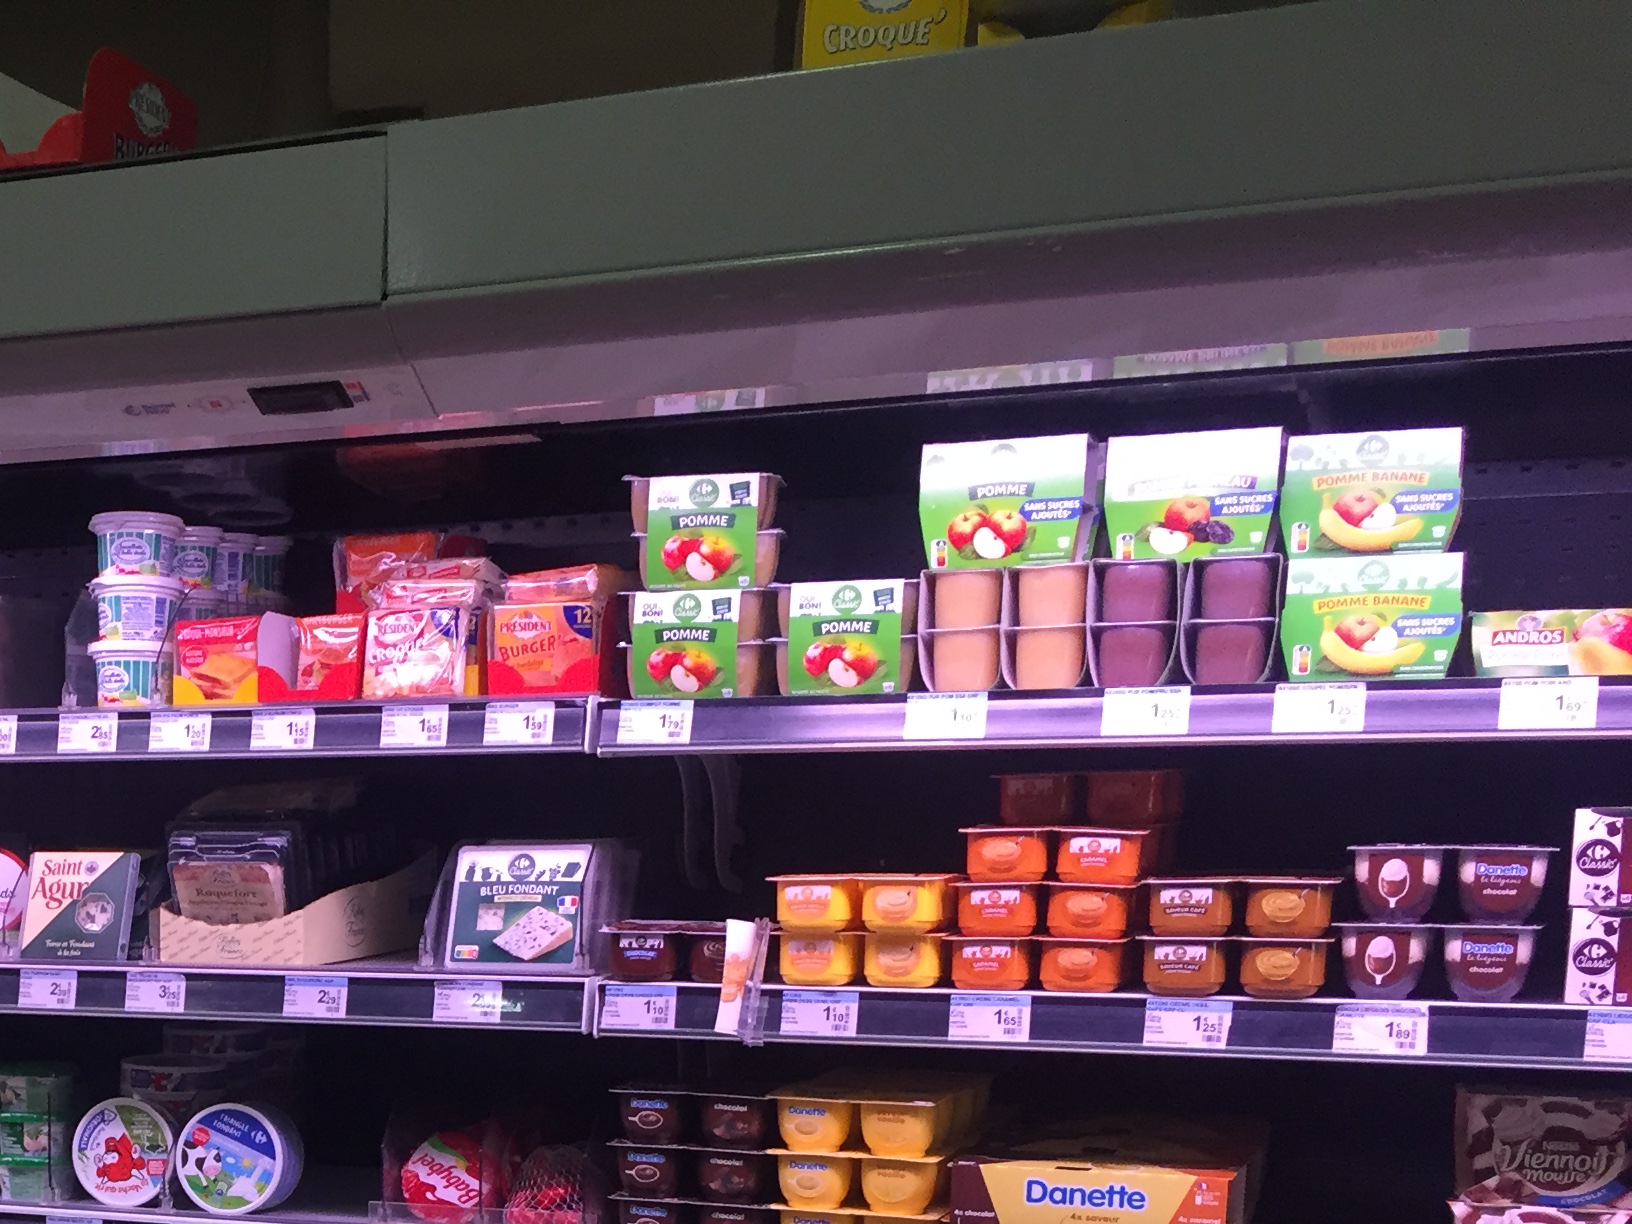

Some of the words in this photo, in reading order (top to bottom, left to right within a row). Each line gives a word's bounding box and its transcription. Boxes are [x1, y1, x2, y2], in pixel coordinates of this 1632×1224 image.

[679, 514, 728, 528] POMME
[1317, 596, 1370, 612] POMME
[1373, 595, 1427, 609] BANANE
[574, 608, 591, 623] 12
[821, 621, 871, 634] POMME
[662, 629, 710, 641] POMME
[1493, 629, 1563, 645] ANDROS
[42, 859, 82, 876] Saint
[1477, 863, 1528, 876] Danette
[31, 877, 89, 909] Agur
[480, 885, 506, 896] BLEU
[509, 884, 559, 896] FONDANT
[1463, 942, 1514, 955] Danette
[790, 1161, 828, 1171] Danette
[1025, 1180, 1147, 1210] Danette
